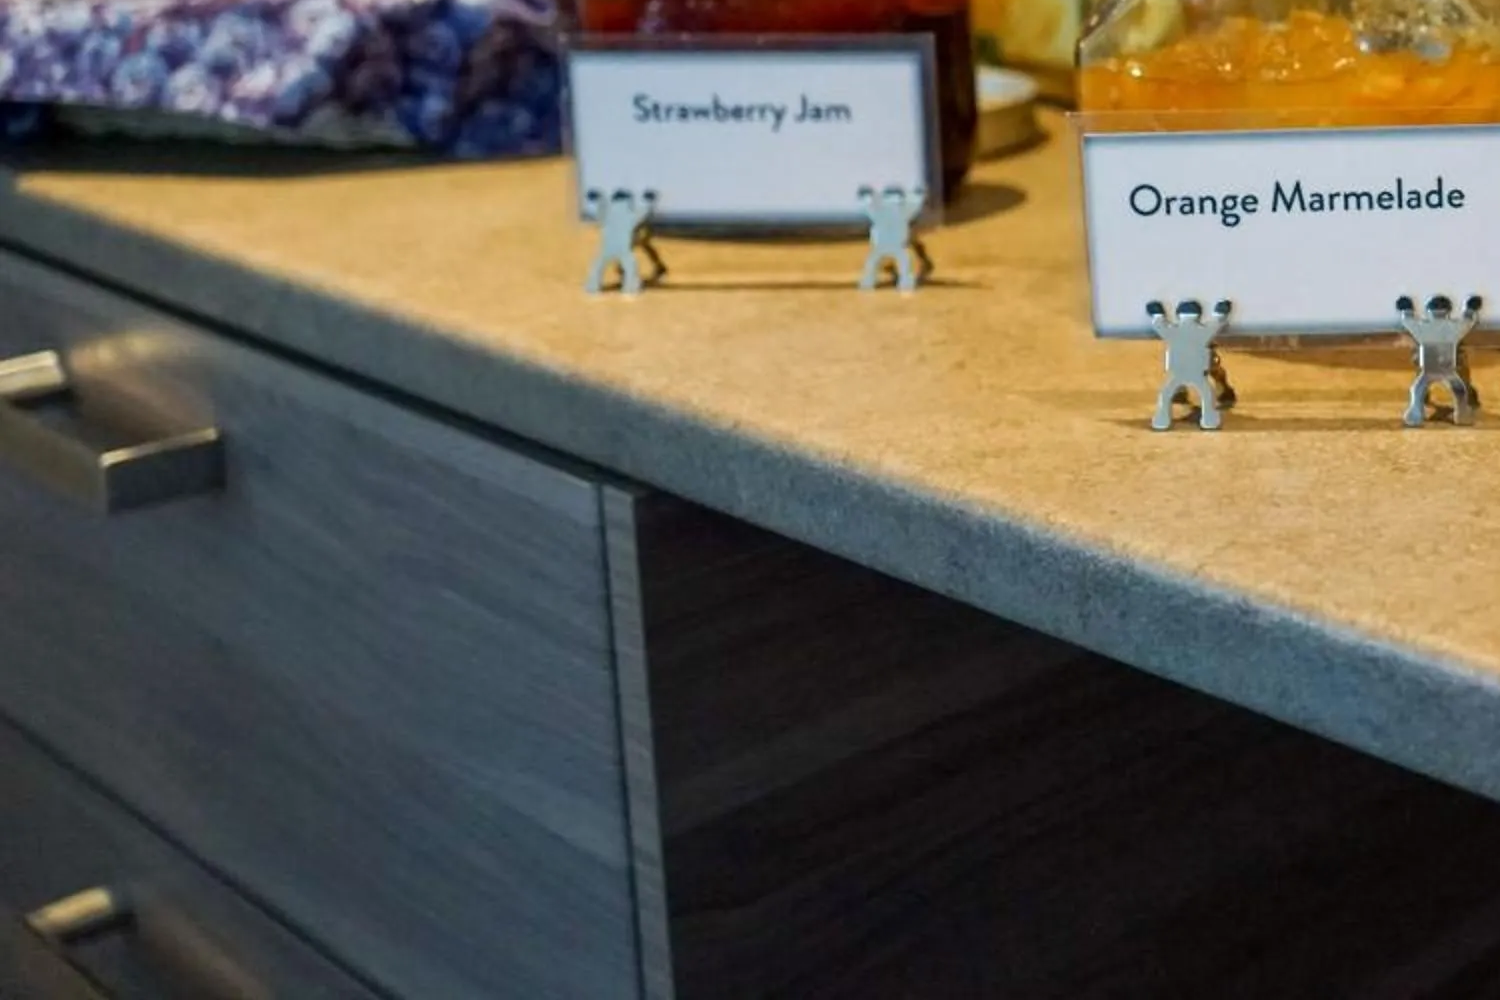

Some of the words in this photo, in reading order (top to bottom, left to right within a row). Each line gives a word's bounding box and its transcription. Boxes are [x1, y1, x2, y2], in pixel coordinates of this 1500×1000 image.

[632, 92, 788, 132] Strawberry
[794, 93, 852, 124] Jam
[1129, 184, 1259, 227] Orange
[1271, 177, 1466, 213] Marmelade
